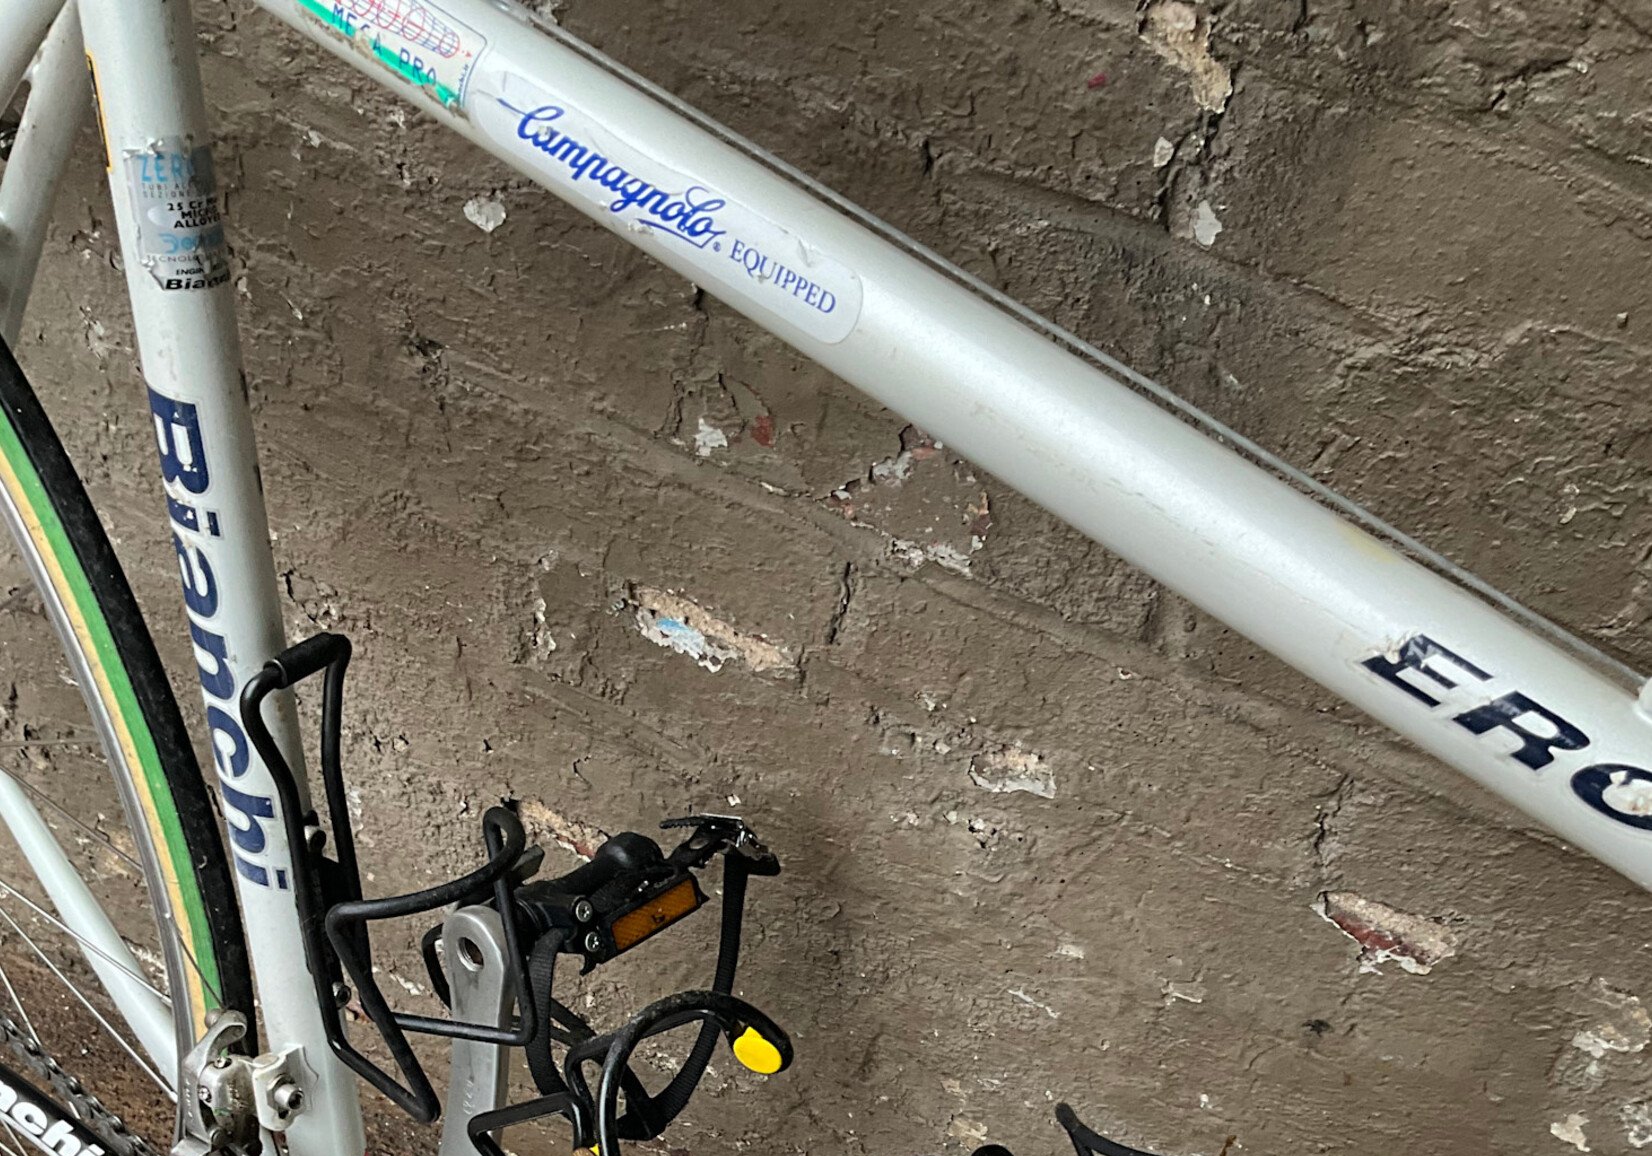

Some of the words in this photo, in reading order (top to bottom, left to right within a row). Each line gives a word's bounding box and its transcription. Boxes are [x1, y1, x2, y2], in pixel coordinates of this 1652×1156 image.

[496, 97, 727, 249] Campagnolo
[729, 239, 837, 314] EQUIPPED
[147, 385, 290, 890] Bianchi
